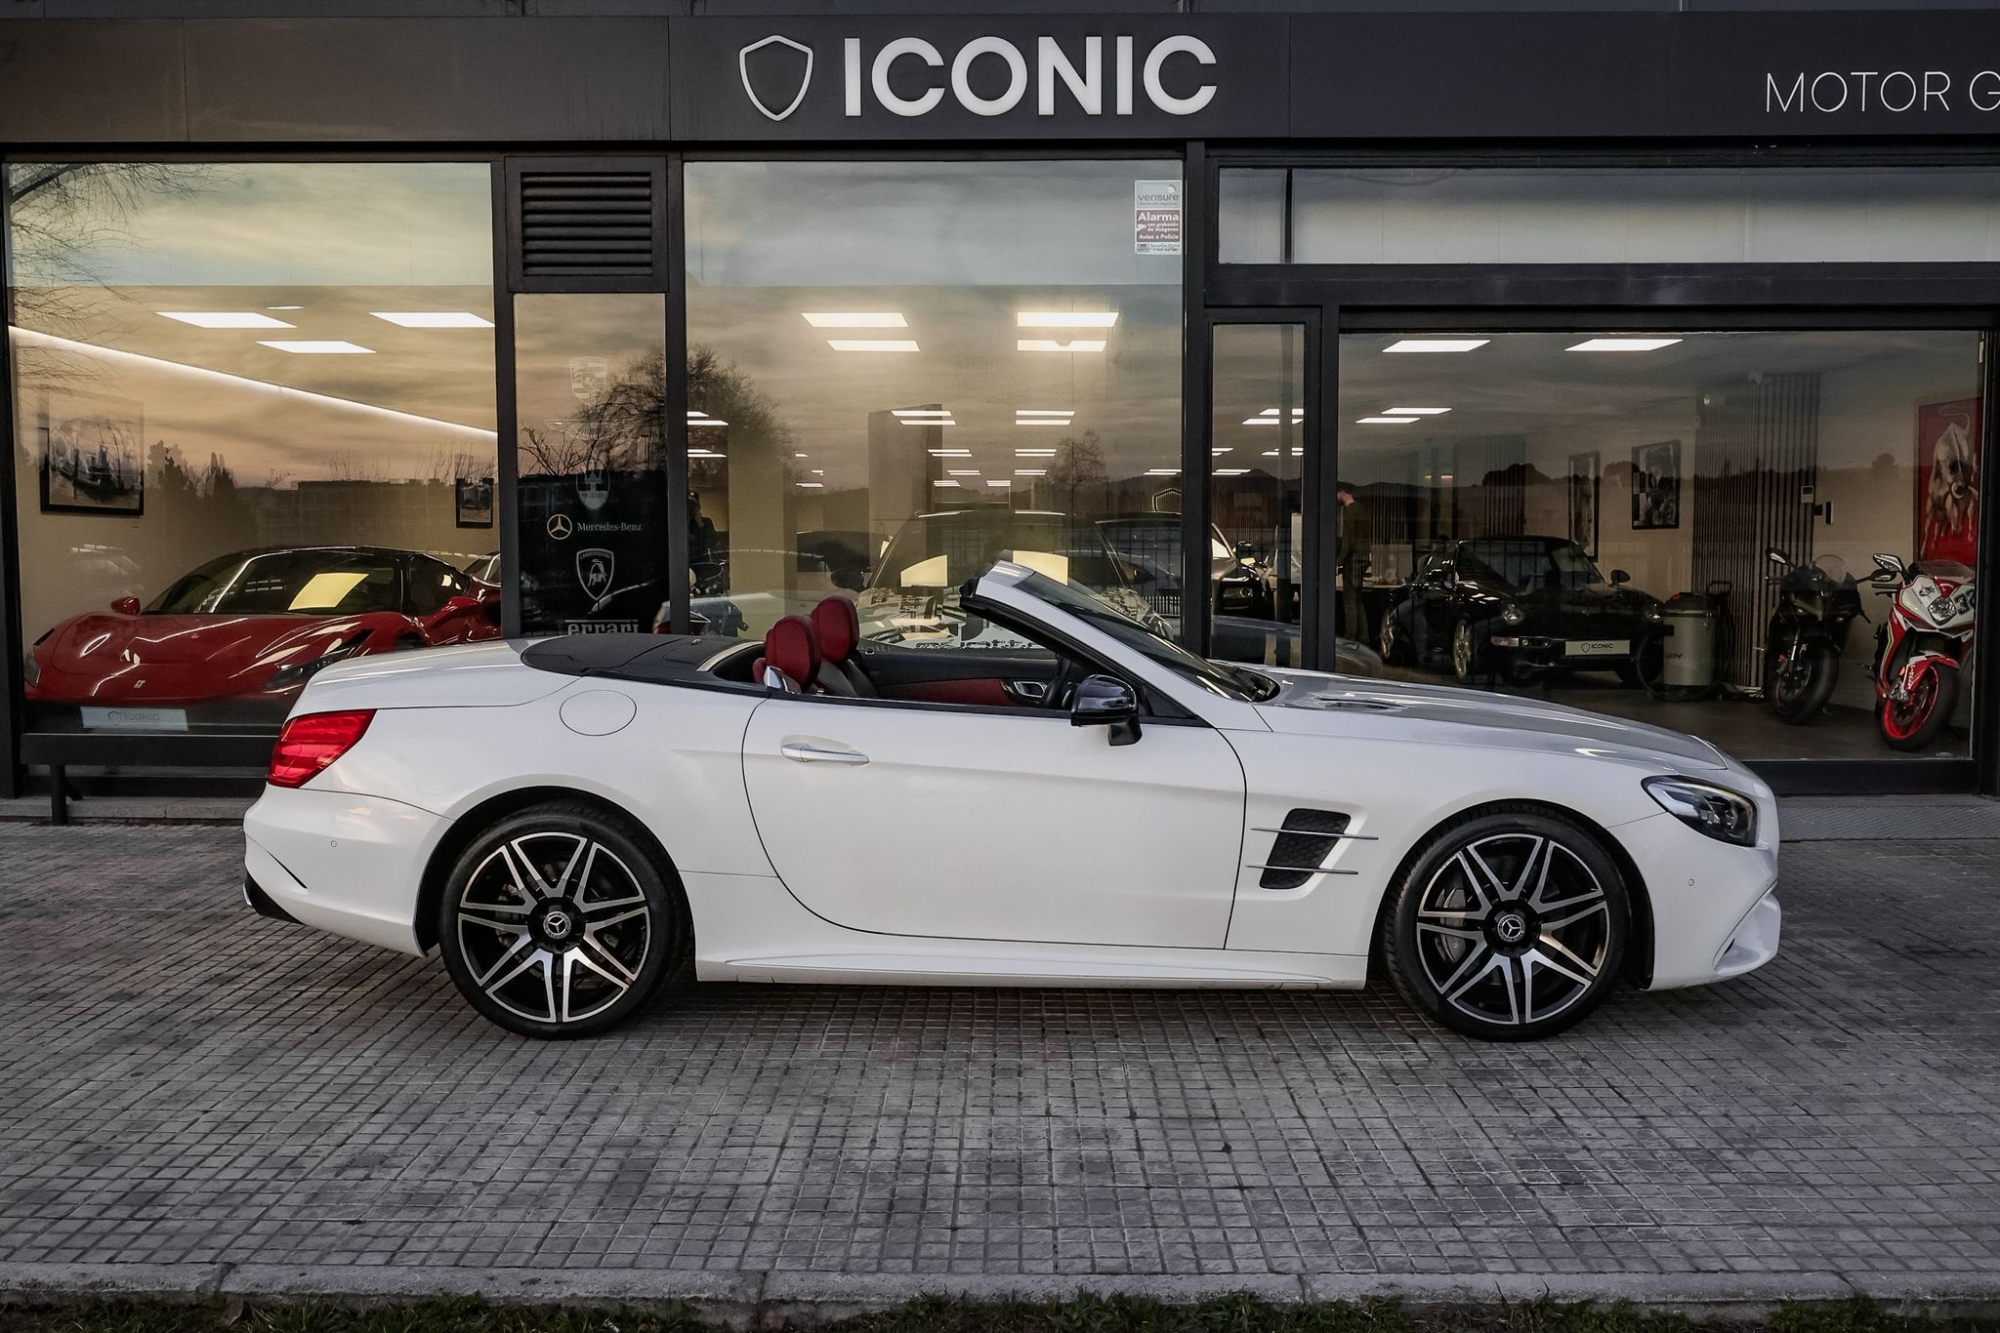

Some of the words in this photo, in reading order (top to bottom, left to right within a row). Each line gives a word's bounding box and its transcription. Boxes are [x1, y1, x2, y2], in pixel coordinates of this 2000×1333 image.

[844, 35, 1218, 117] ICONIC
[1766, 71, 1951, 112] MOTOR
[1138, 212, 1179, 221] Alarma
[577, 522, 643, 532] Mercedes-Benz
